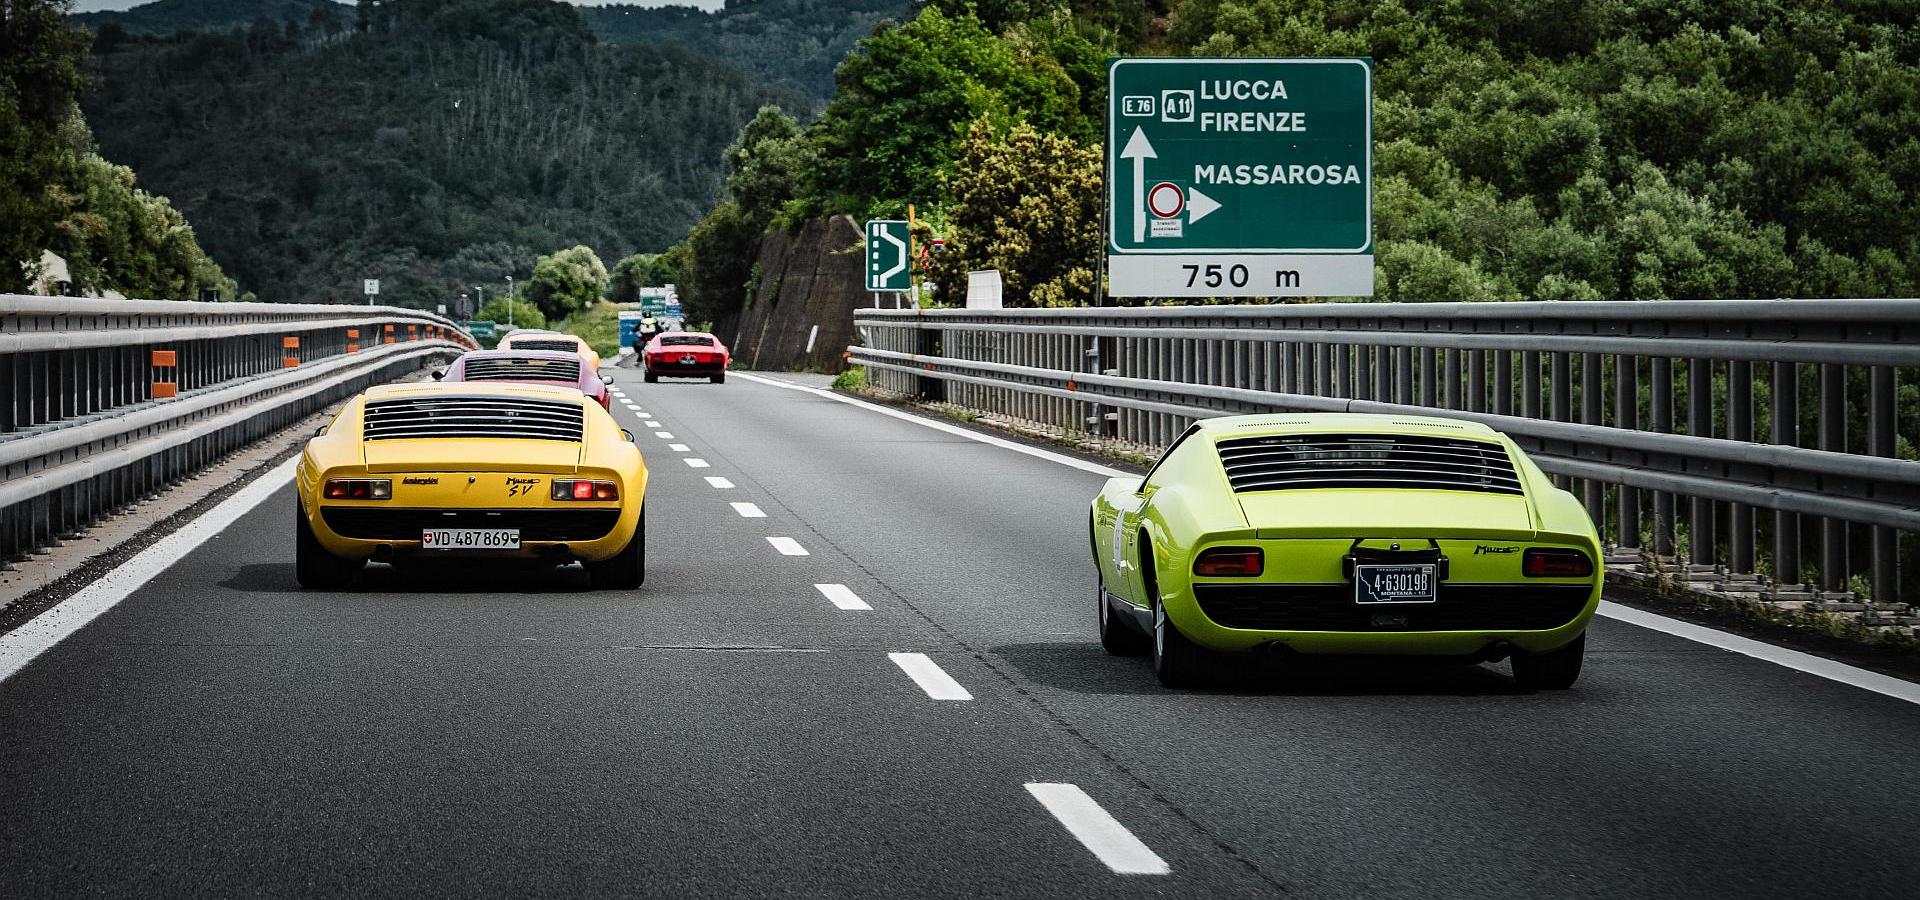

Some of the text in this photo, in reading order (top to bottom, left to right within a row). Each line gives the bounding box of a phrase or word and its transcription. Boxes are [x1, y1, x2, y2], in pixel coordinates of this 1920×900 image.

[1200, 80, 1288, 100] LUCCA
[1126, 100, 1151, 112] E 76
[1200, 112, 1306, 132] FIRENZE
[1194, 164, 1361, 185] MASSAROSA
[1182, 264, 1300, 288] 750 m
